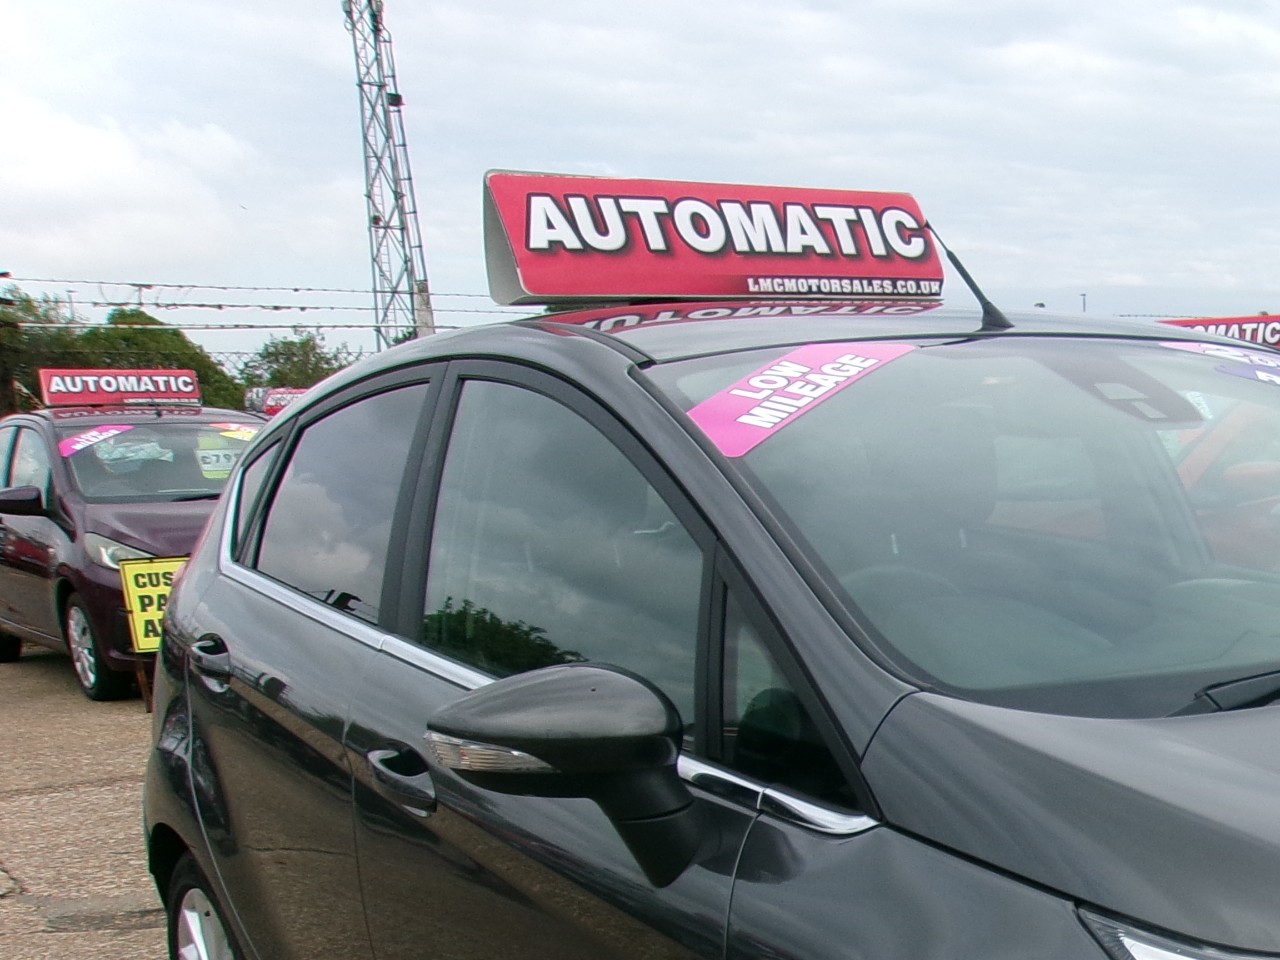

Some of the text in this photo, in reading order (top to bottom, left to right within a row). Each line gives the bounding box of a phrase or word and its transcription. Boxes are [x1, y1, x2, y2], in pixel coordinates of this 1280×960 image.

[527, 194, 928, 258] AUTOMATIC
[747, 277, 942, 296] LMCMOTORSALES.CO.UK
[50, 374, 195, 393] AUTOMATIC
[728, 360, 813, 400] LOW
[735, 353, 881, 429] MILEAGE
